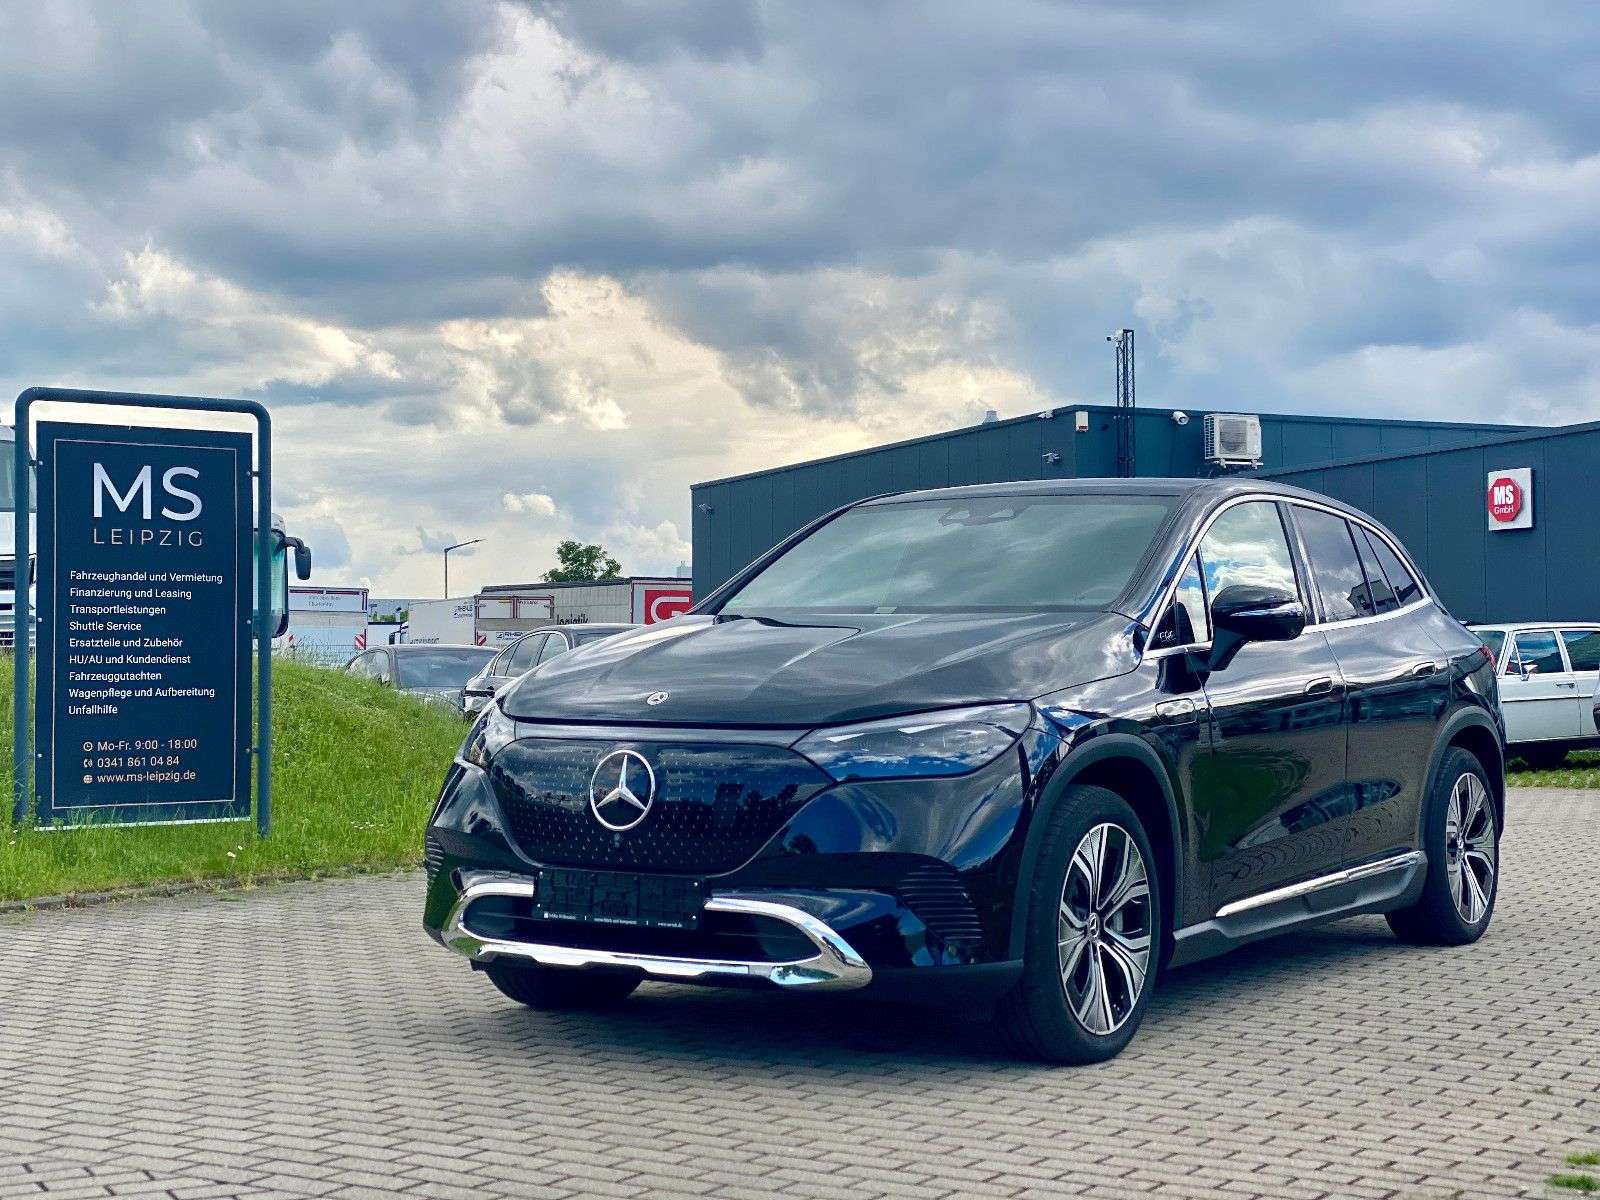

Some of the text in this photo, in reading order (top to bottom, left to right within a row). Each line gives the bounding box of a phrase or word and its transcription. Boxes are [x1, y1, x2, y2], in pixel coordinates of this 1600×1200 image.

[93, 462, 203, 522] MS
[1493, 484, 1514, 505] MS
[1494, 505, 1514, 515] GmbH
[93, 527, 203, 547] LEIPZIG
[70, 570, 223, 585] Fahrzeughandel und Vermietung
[70, 587, 192, 601] Finanzierung und Leasing
[69, 604, 166, 617] Transportleistungen
[69, 620, 142, 631] Shuttle Service
[69, 637, 184, 648] Ersatzteile und Zubehör
[69, 654, 191, 665] HU/AU und Kundendienst
[69, 671, 162, 683] Fahrzeuggutachten
[68, 687, 215, 700] Wagenpflege und Aufbereitung
[68, 704, 118, 715] Unfallhilfe
[97, 740, 132, 752] Mo-Fr.
[134, 739, 159, 750] 9:00
[167, 738, 198, 749] 18:00
[97, 755, 180, 768] 0341 861 04 84
[96, 769, 196, 784] www.ms-leipzig.de
